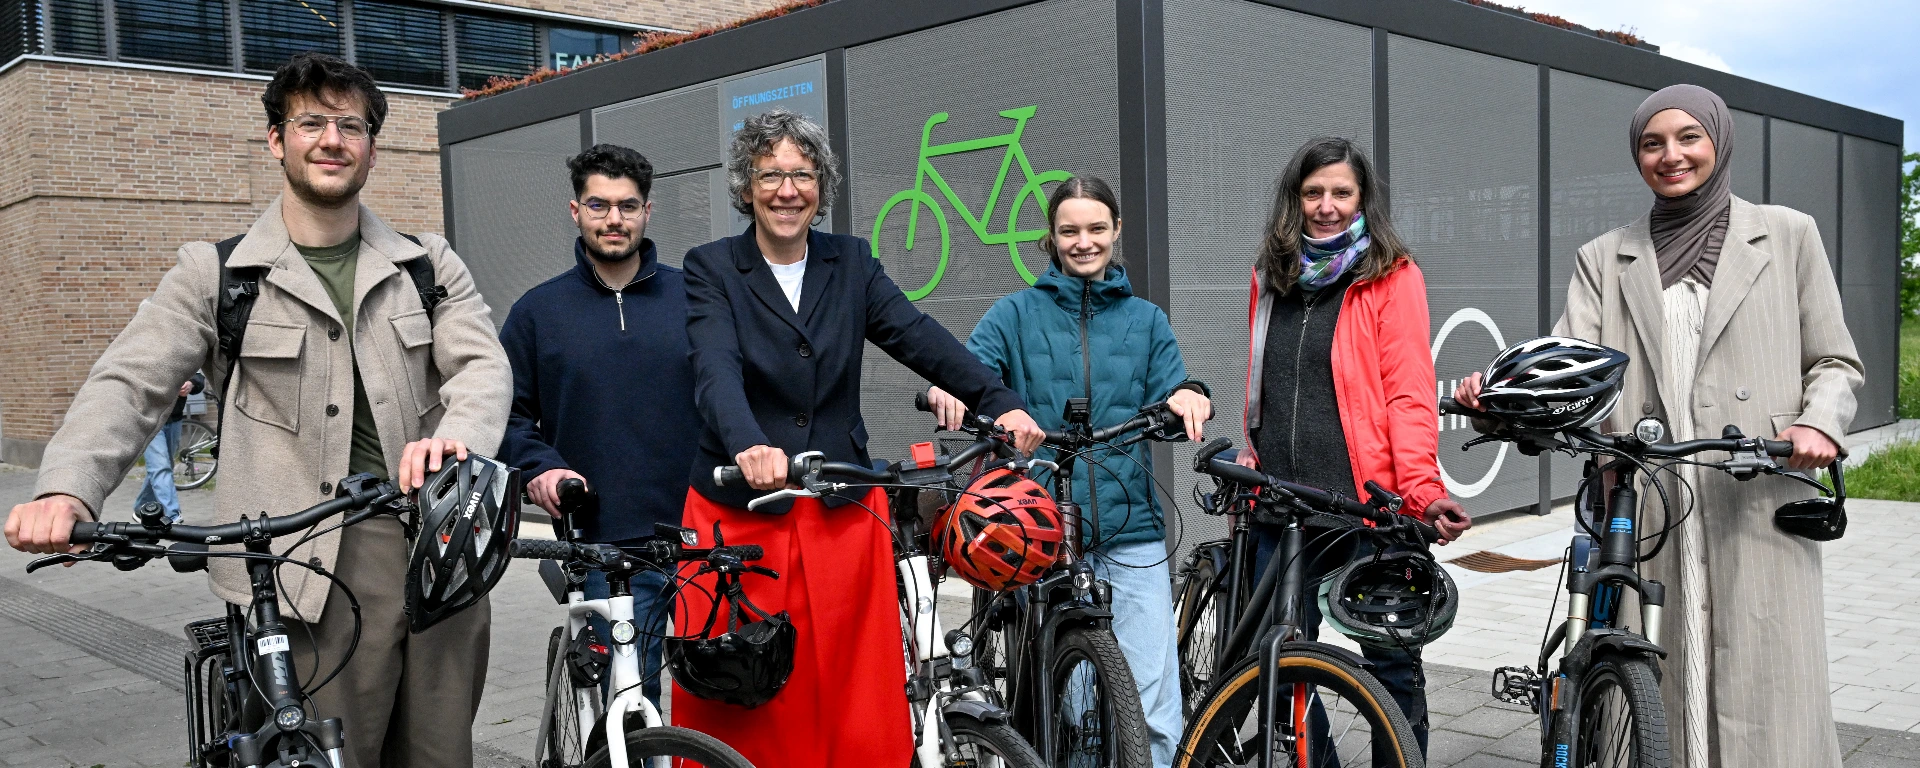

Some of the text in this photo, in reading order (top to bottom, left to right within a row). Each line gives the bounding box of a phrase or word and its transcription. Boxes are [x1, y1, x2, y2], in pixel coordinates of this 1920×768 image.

[732, 81, 813, 109] ÖFFNUNGSZEITEN
[1567, 396, 1594, 411] GIRO
[1555, 744, 1569, 768] ROCK
